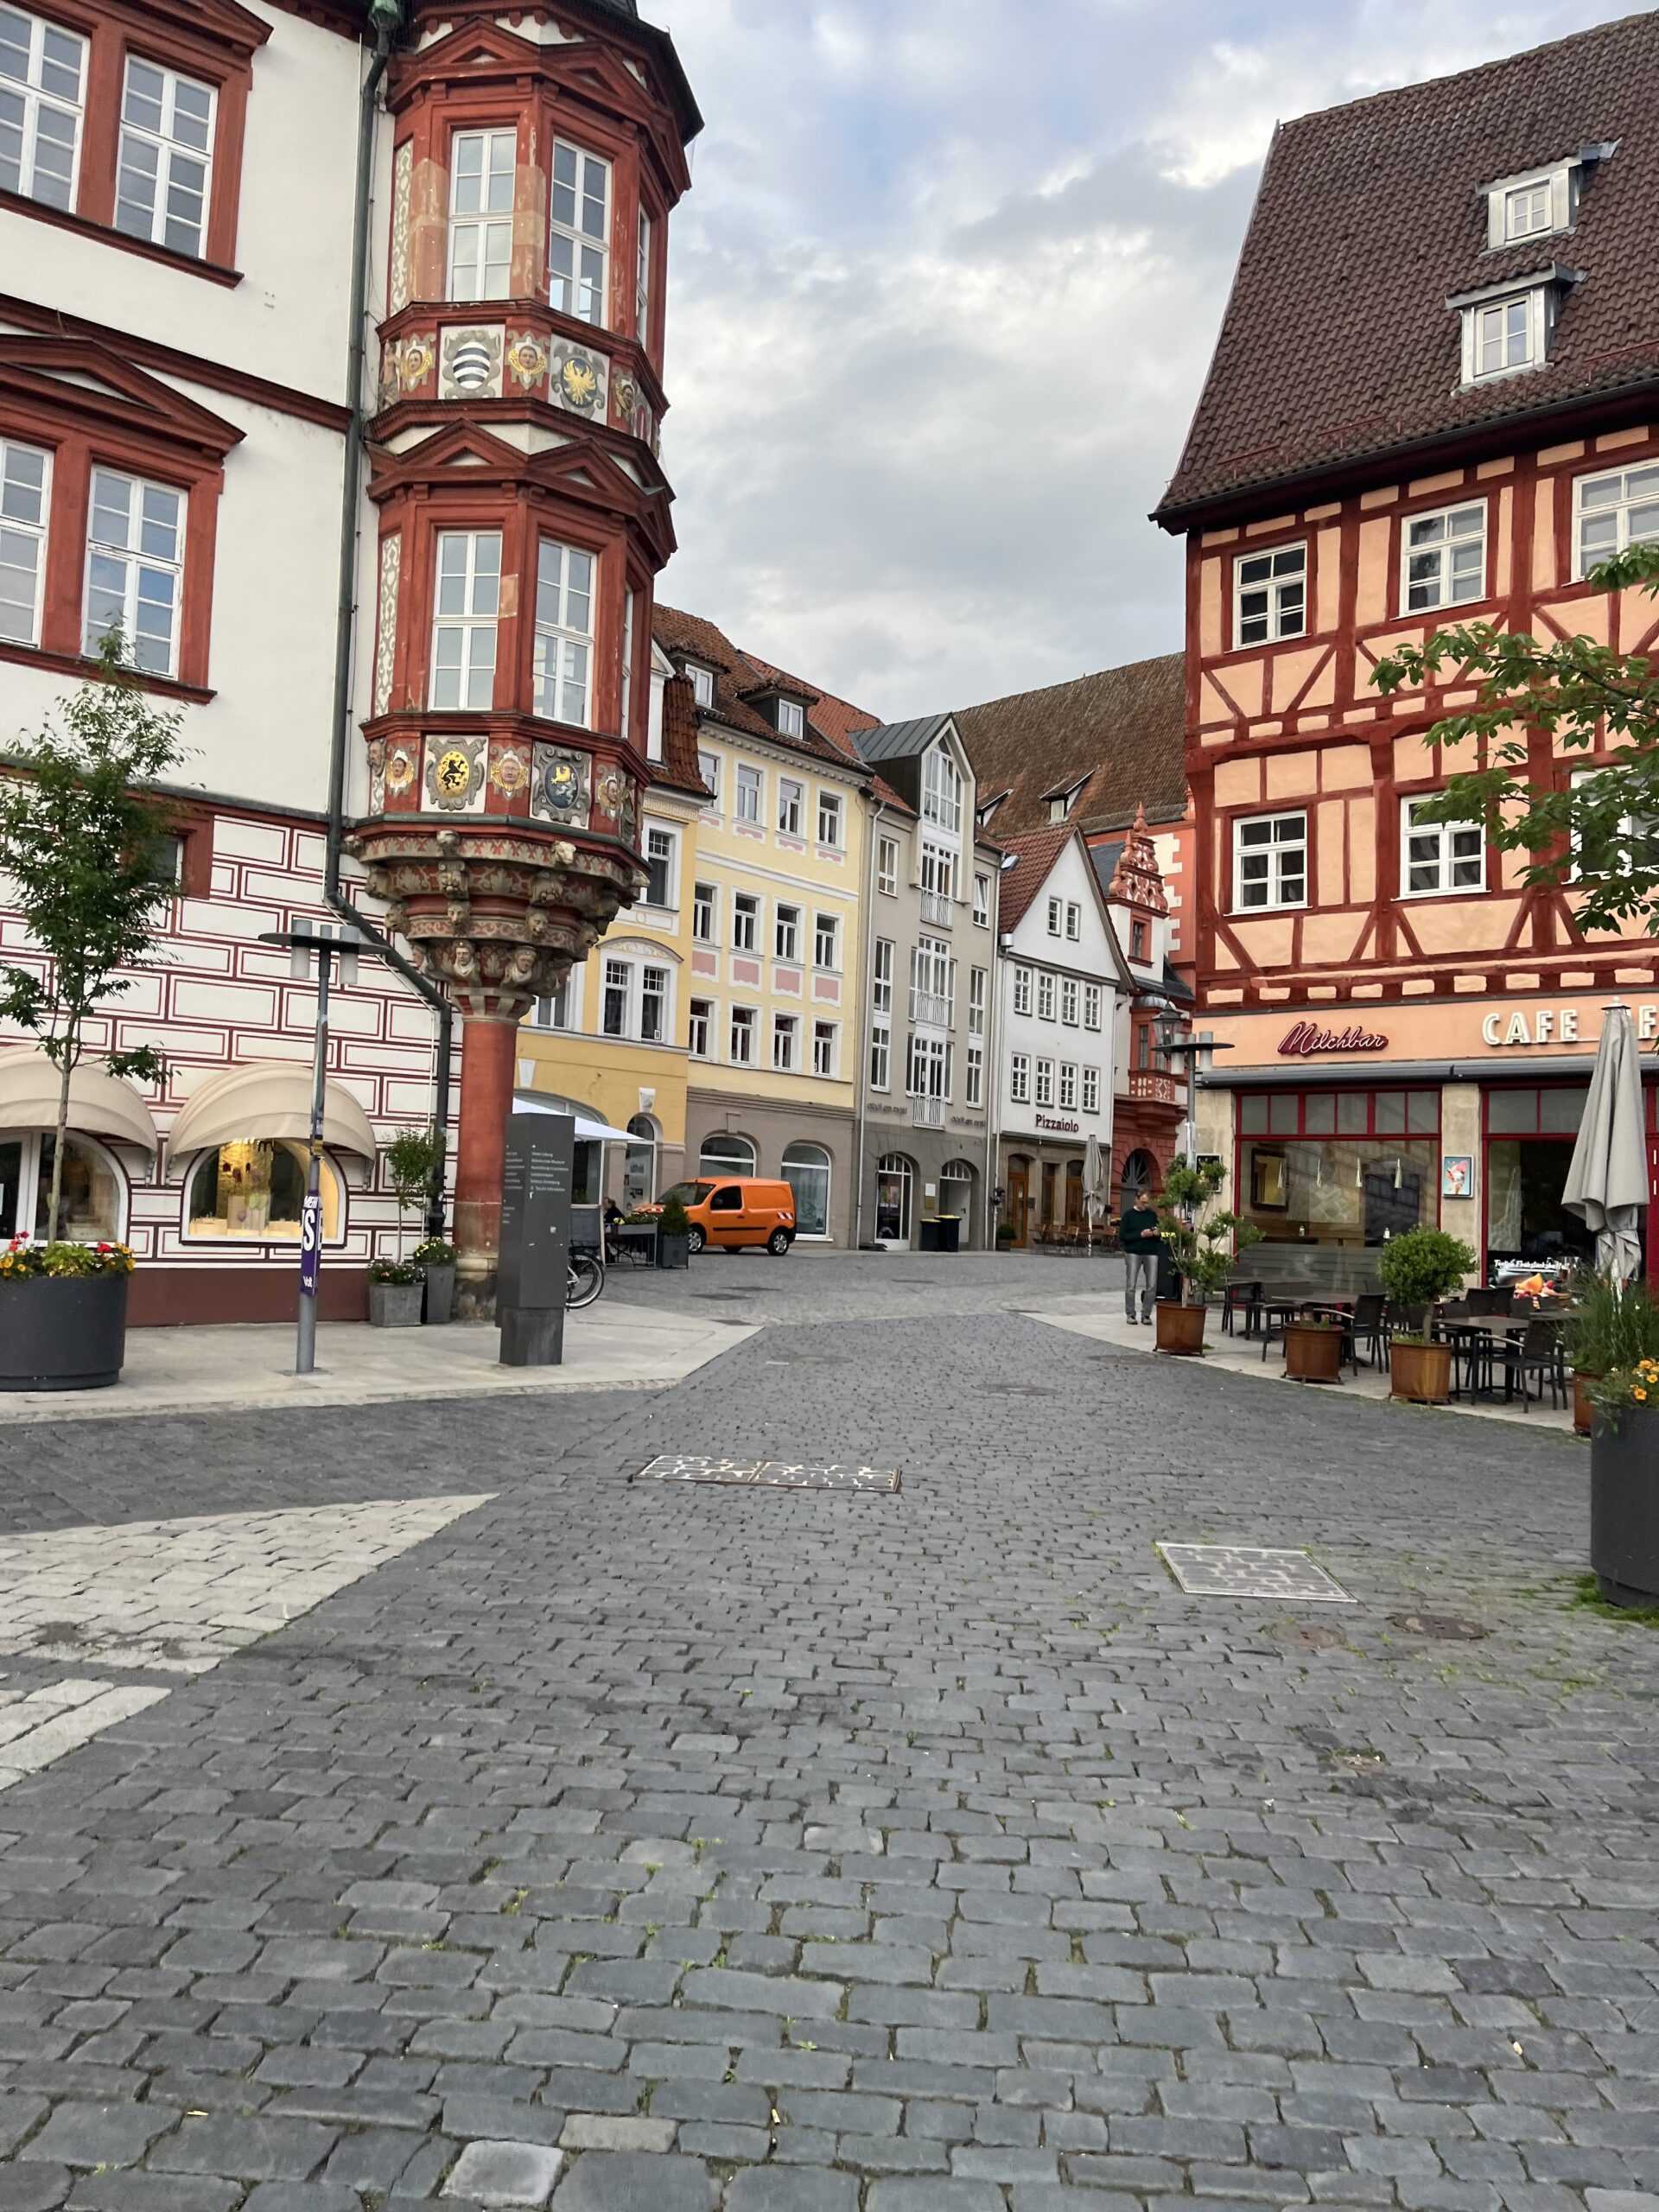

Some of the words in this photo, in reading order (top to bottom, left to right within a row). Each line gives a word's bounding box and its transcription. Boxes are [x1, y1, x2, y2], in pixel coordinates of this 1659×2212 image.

[1278, 1021, 1389, 1058] Milchbar
[1482, 1008, 1579, 1046] CAFE
[1035, 1113, 1079, 1133] Pizzaiolo
